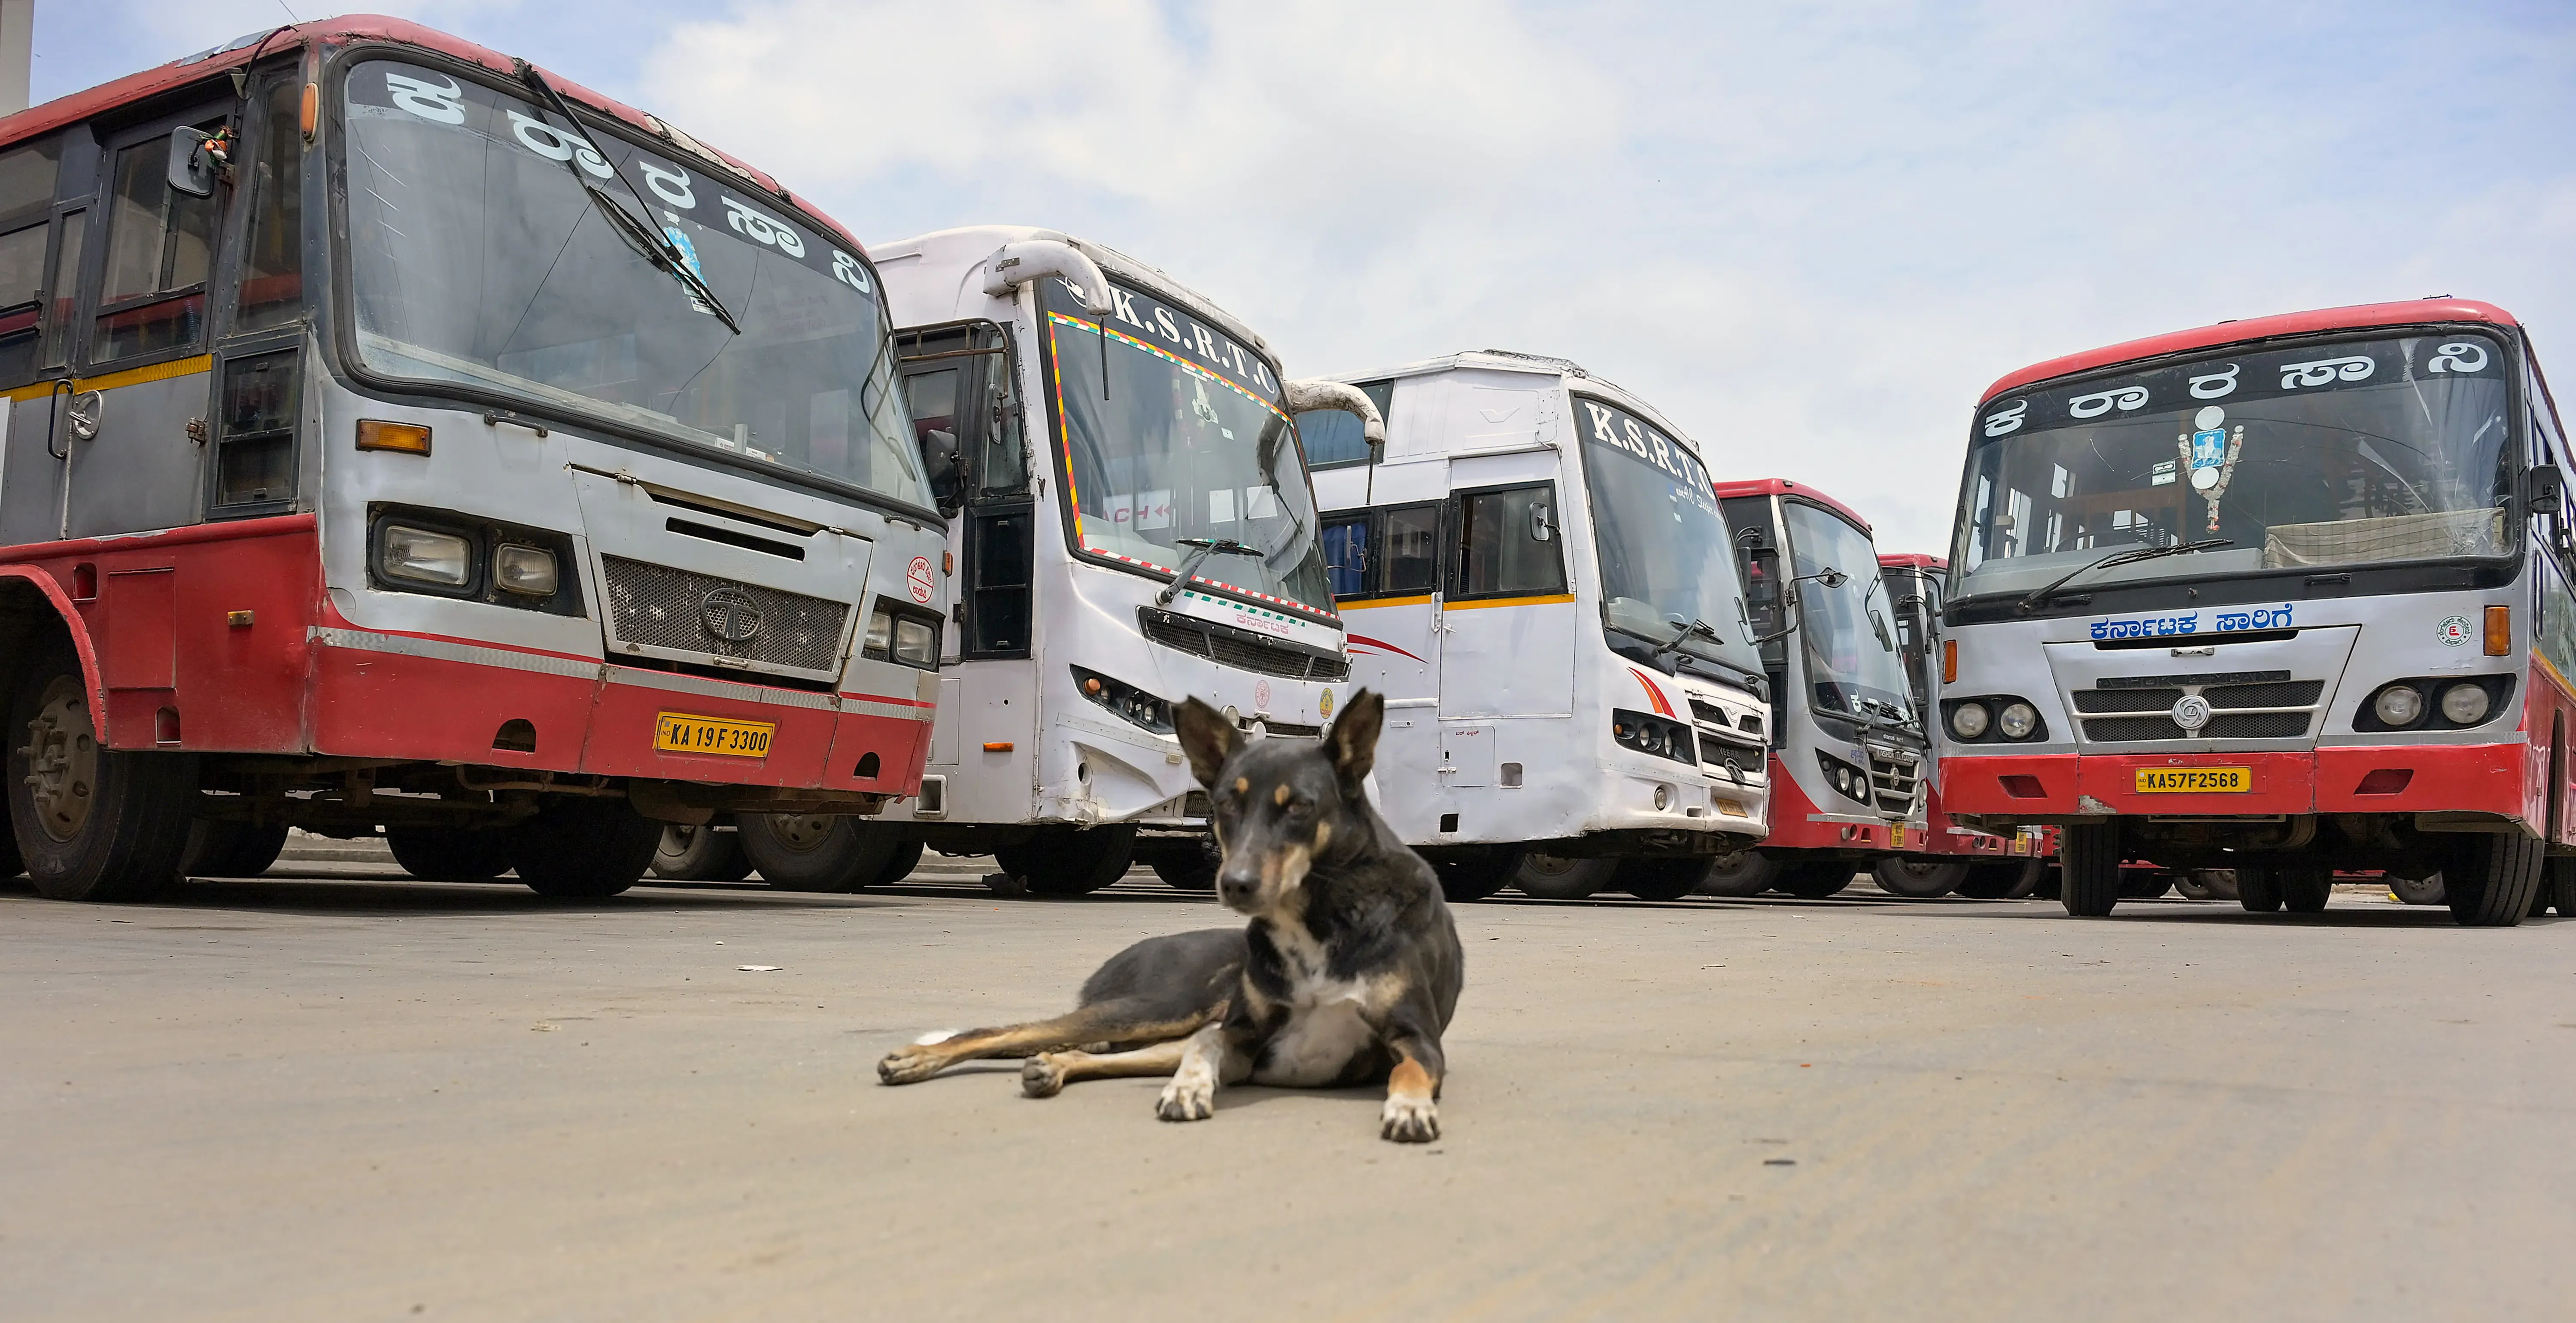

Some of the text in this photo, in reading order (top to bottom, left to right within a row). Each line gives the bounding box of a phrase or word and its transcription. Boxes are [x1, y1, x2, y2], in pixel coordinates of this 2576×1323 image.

[1109, 285, 1275, 394] K.S.R.T.C
[1236, 613, 1289, 634] ಕರ್ನಾಟಕ
[2090, 603, 2293, 639] ಕರ್ನಾಟಕ ಸಾರಿಗೆ
[1718, 746, 1740, 759] VEERA
[2148, 773, 2238, 788] KA57F2568
